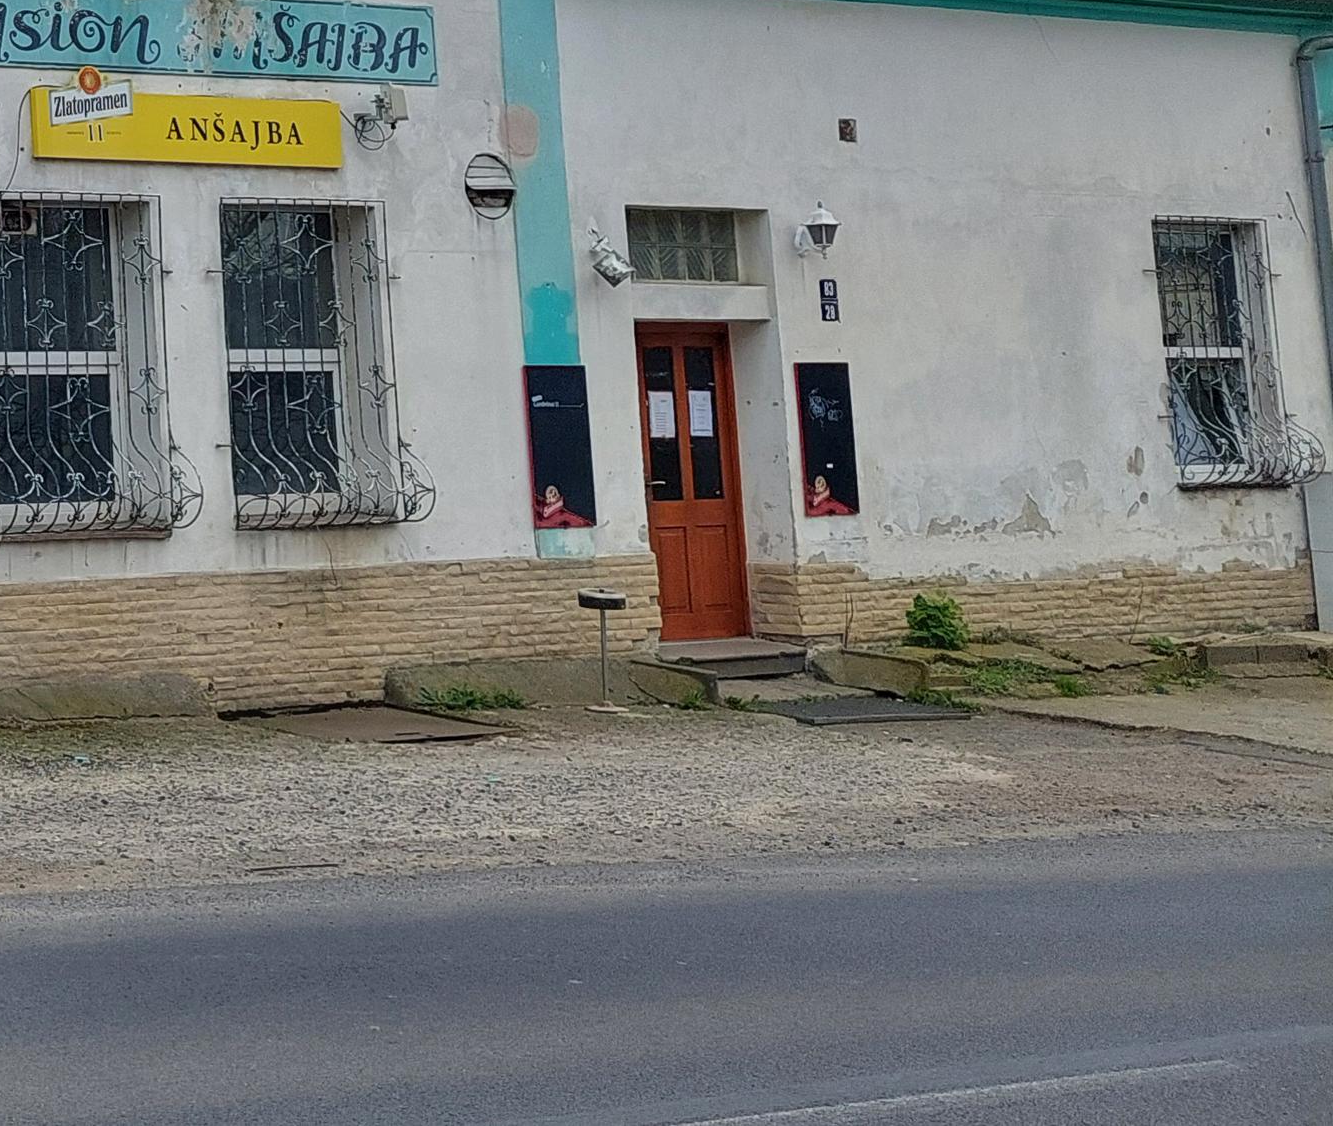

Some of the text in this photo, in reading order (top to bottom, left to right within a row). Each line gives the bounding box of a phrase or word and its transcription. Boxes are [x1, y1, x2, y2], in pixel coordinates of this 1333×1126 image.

[53, 93, 129, 118] Zlatopramen
[88, 124, 103, 142] 11
[165, 112, 304, 151] ANŠAJBA
[824, 304, 836, 320] 28
